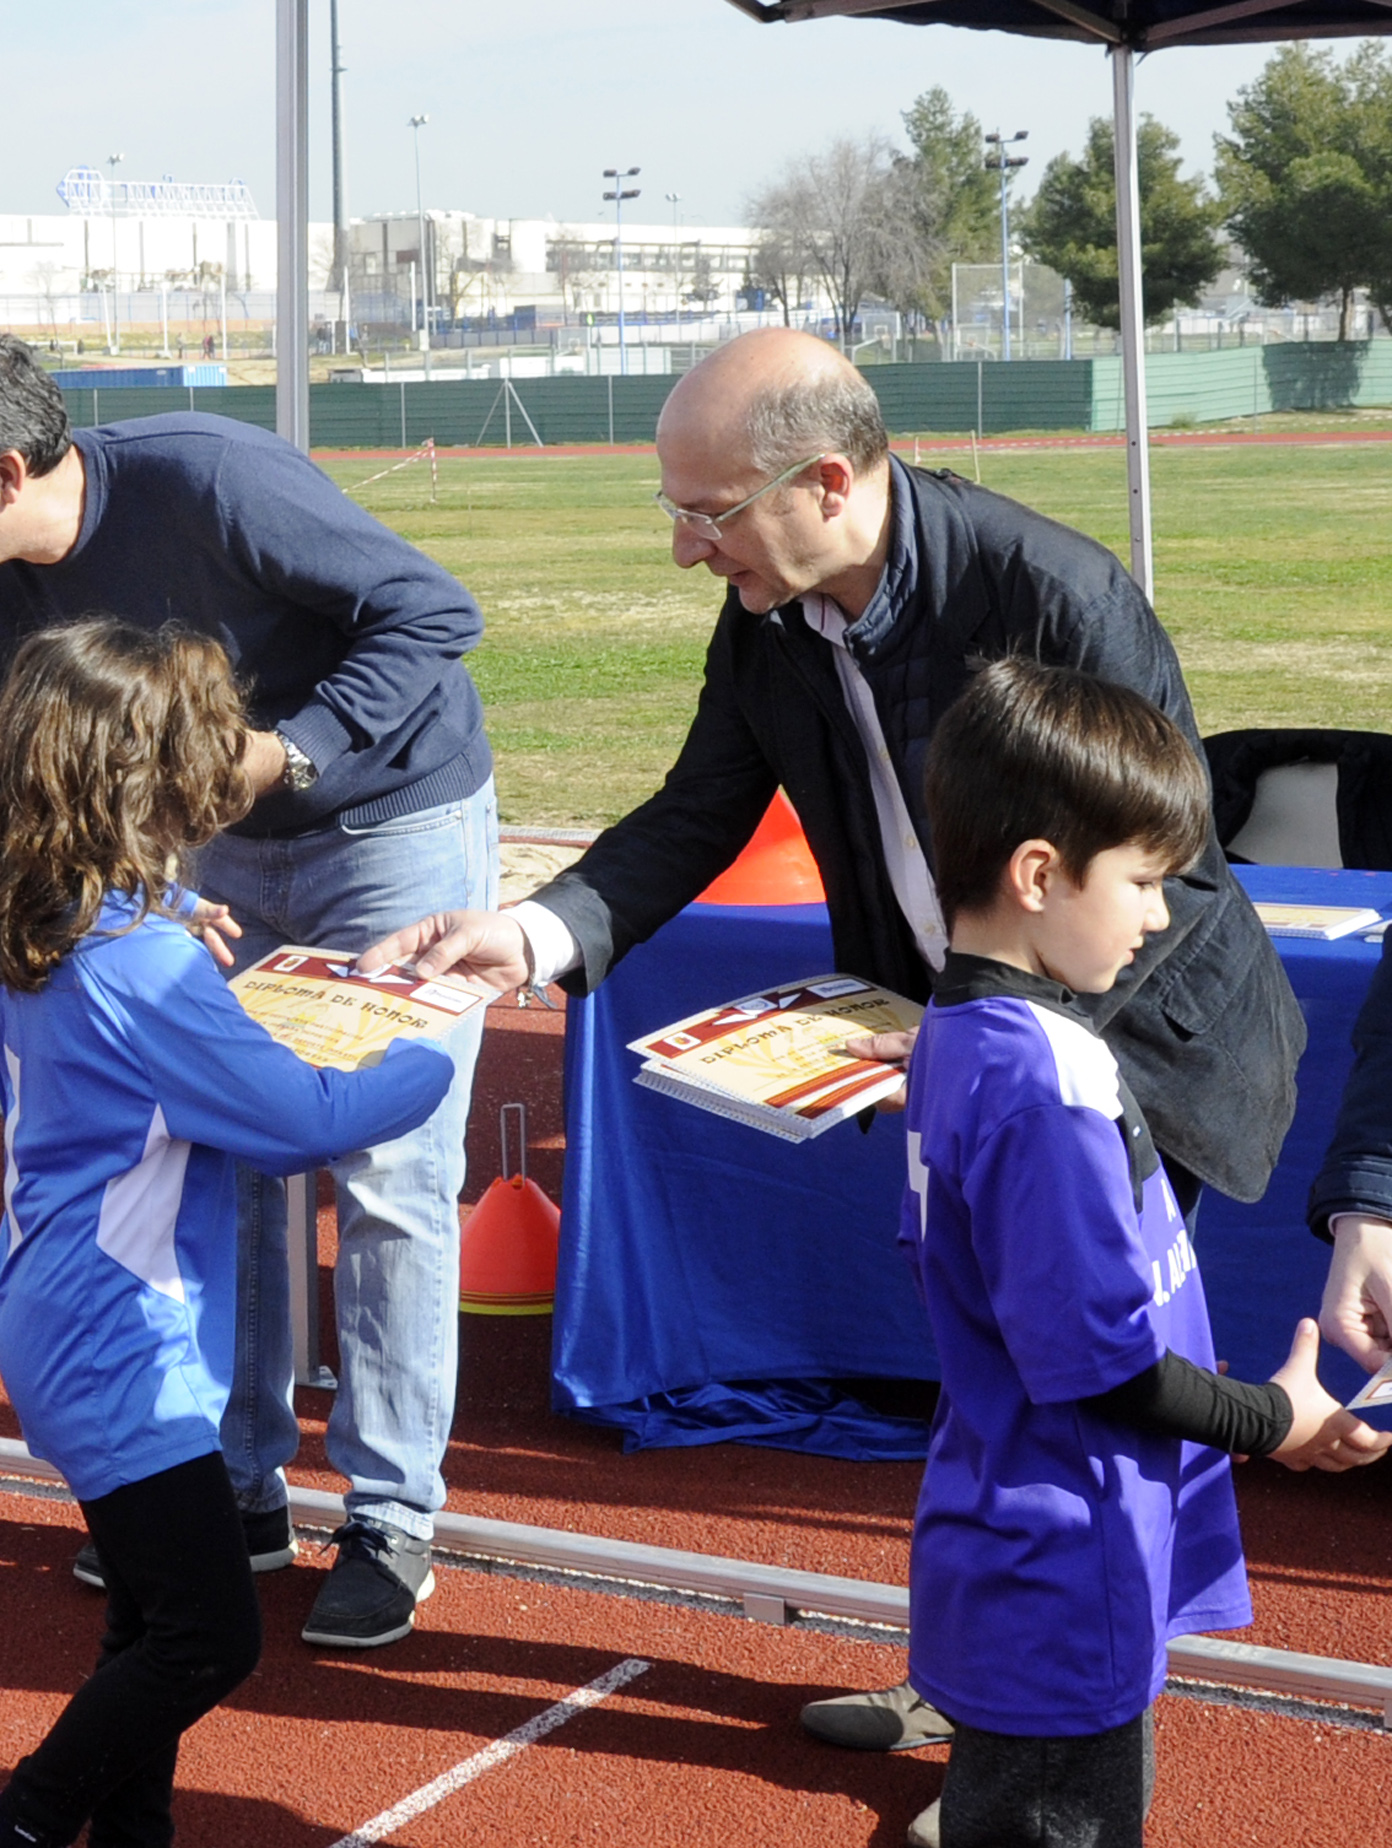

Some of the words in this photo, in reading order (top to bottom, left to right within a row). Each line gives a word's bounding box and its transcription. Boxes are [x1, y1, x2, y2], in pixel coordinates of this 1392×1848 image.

[243, 980, 328, 1001] DIPLOMA
[331, 994, 358, 1007] DE
[360, 1001, 429, 1030] HONOR
[700, 1024, 792, 1065] DIPLOMA
[795, 1014, 824, 1027] DE
[824, 998, 890, 1018] HONOR
